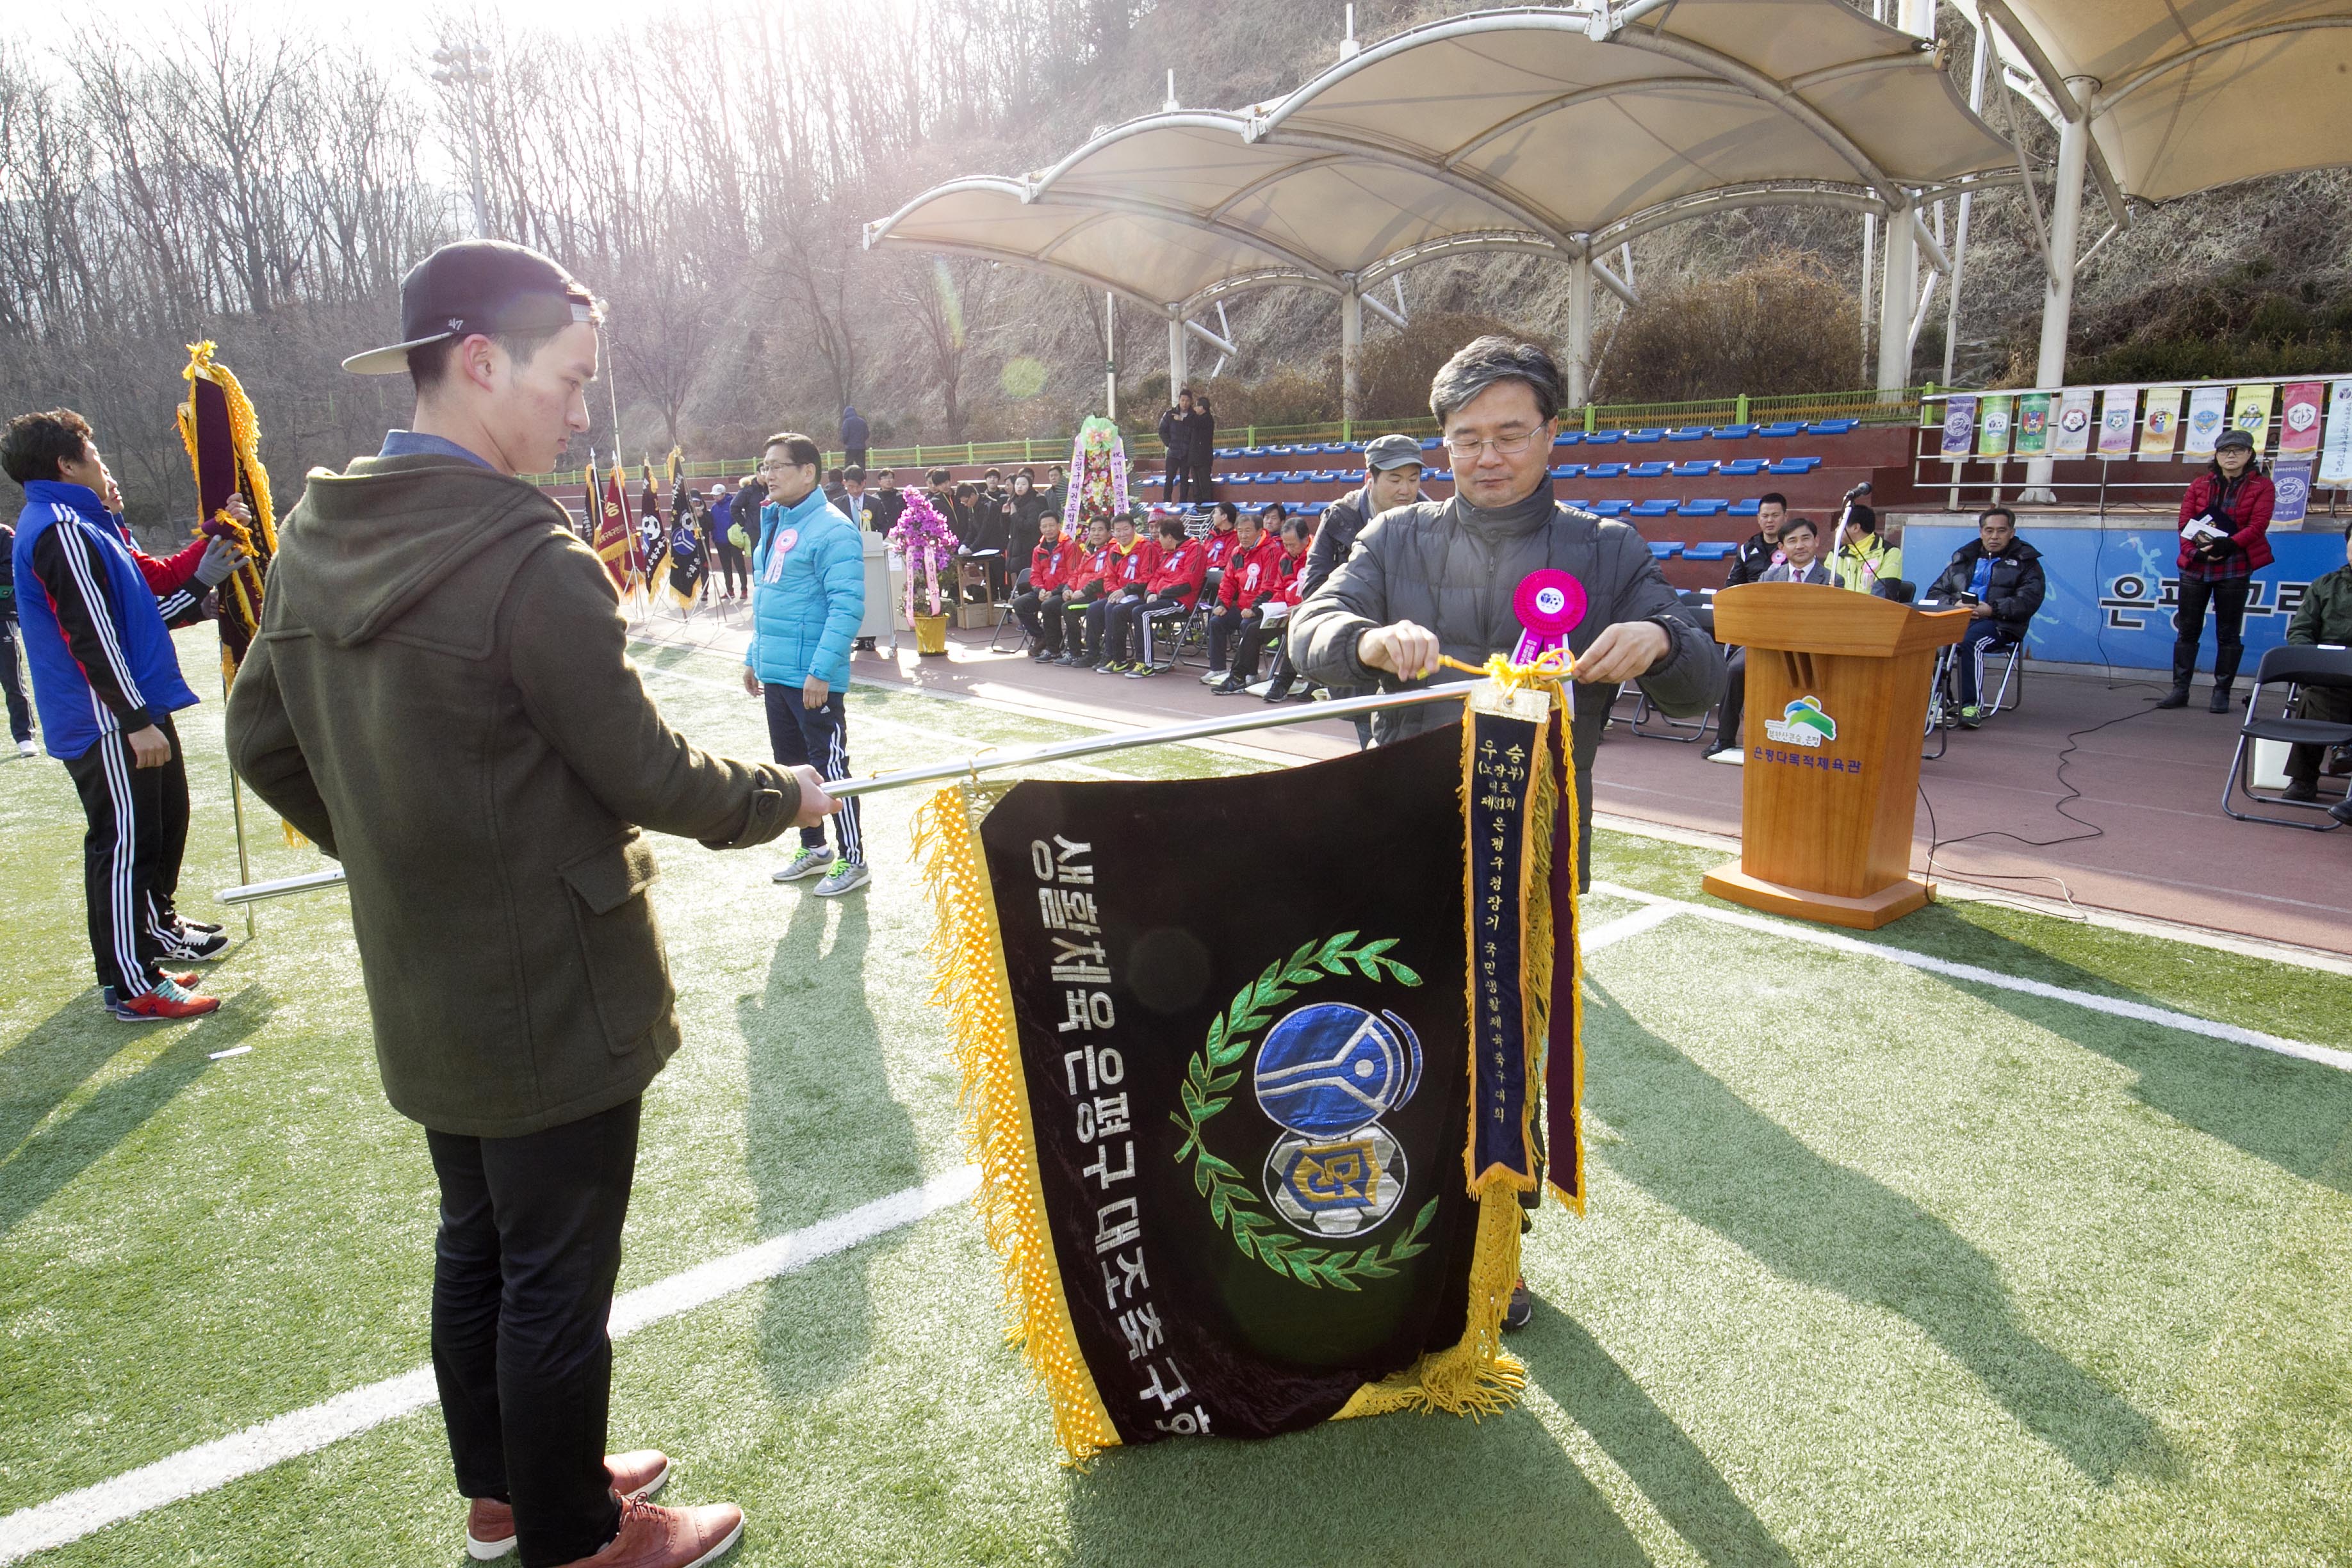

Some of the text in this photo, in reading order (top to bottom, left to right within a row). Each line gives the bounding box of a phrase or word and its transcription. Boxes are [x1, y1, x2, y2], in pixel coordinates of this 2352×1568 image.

[1754, 746, 1862, 773] 은평다목적체육관
[1031, 833, 1116, 1032] 생활체육
[1063, 1045, 1136, 1189] 은평구
